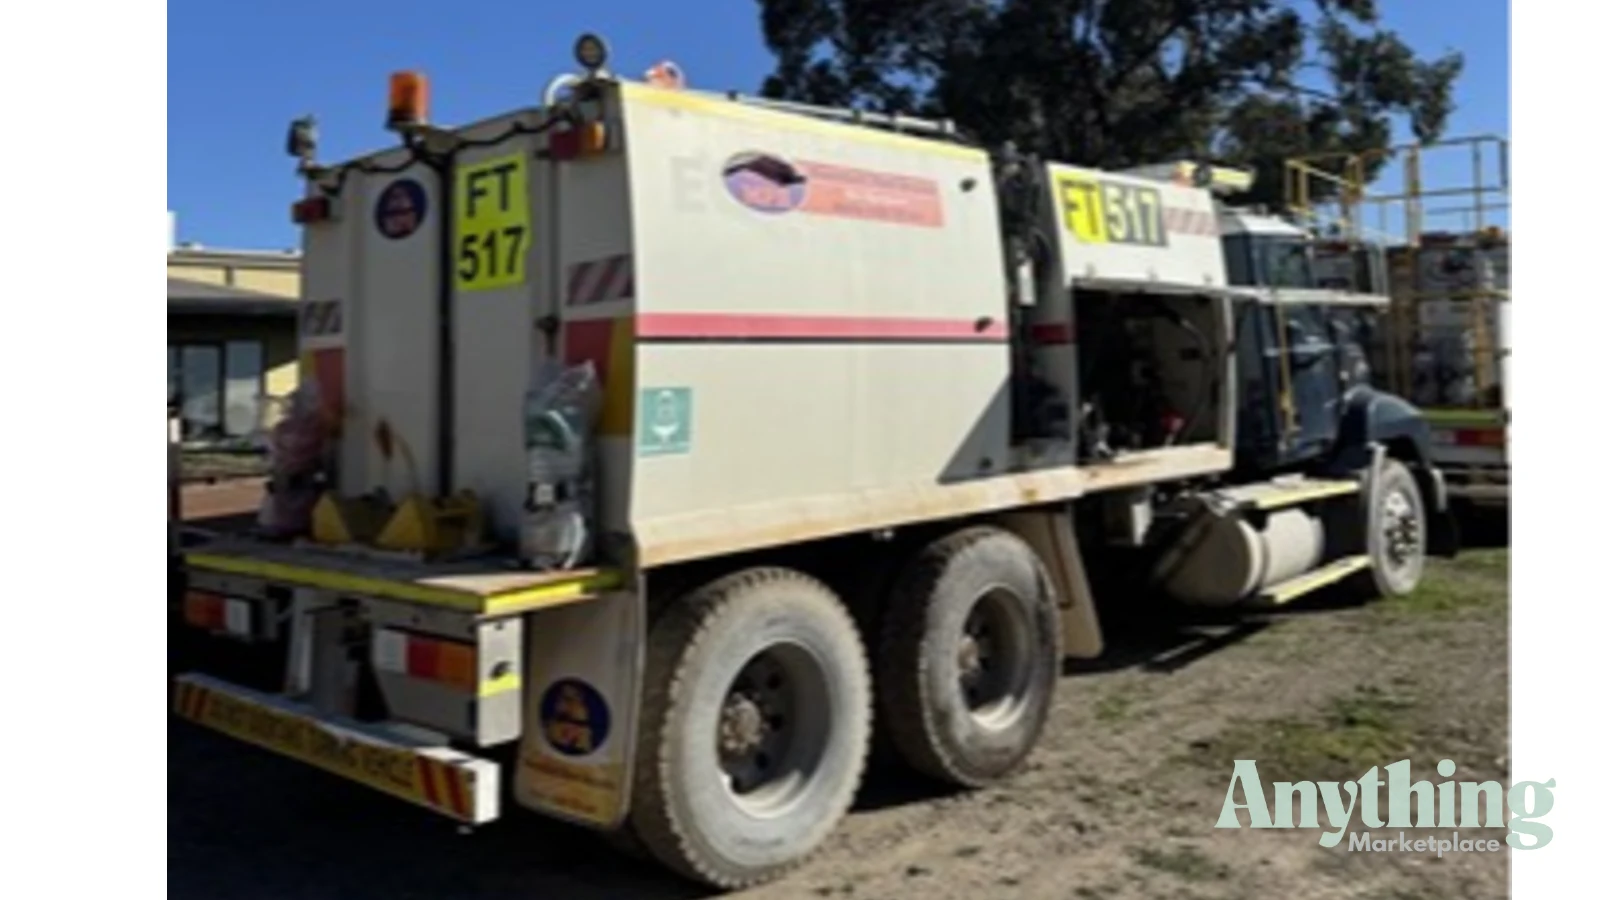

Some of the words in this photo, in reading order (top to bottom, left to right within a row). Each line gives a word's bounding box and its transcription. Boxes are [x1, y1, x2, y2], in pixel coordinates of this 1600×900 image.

[466, 161, 518, 218] FT
[1061, 179, 1099, 237] FT
[1104, 183, 1163, 243] 517
[459, 225, 524, 282] 517
